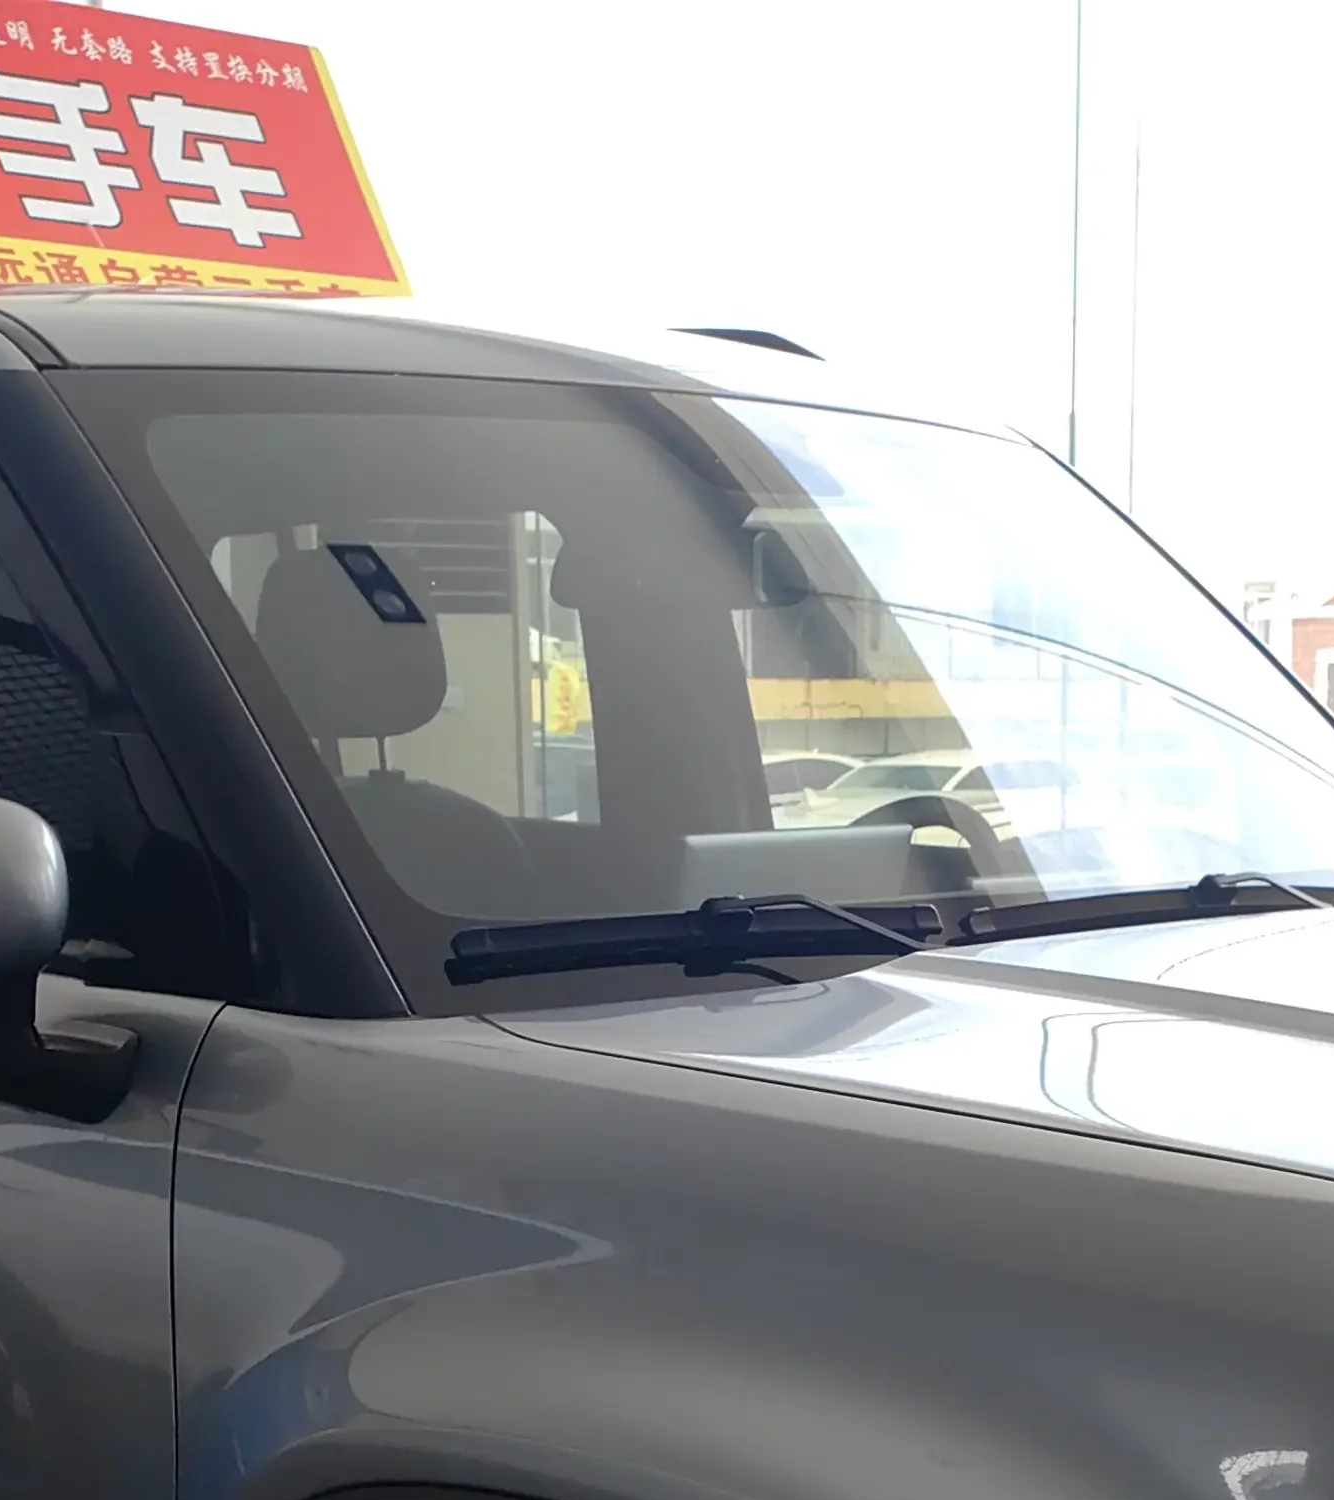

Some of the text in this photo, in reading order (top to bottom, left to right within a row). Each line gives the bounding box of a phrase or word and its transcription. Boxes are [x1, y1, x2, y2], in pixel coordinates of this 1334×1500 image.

[50, 27, 133, 66] 无套路
[149, 40, 309, 94] 支持置换分期
